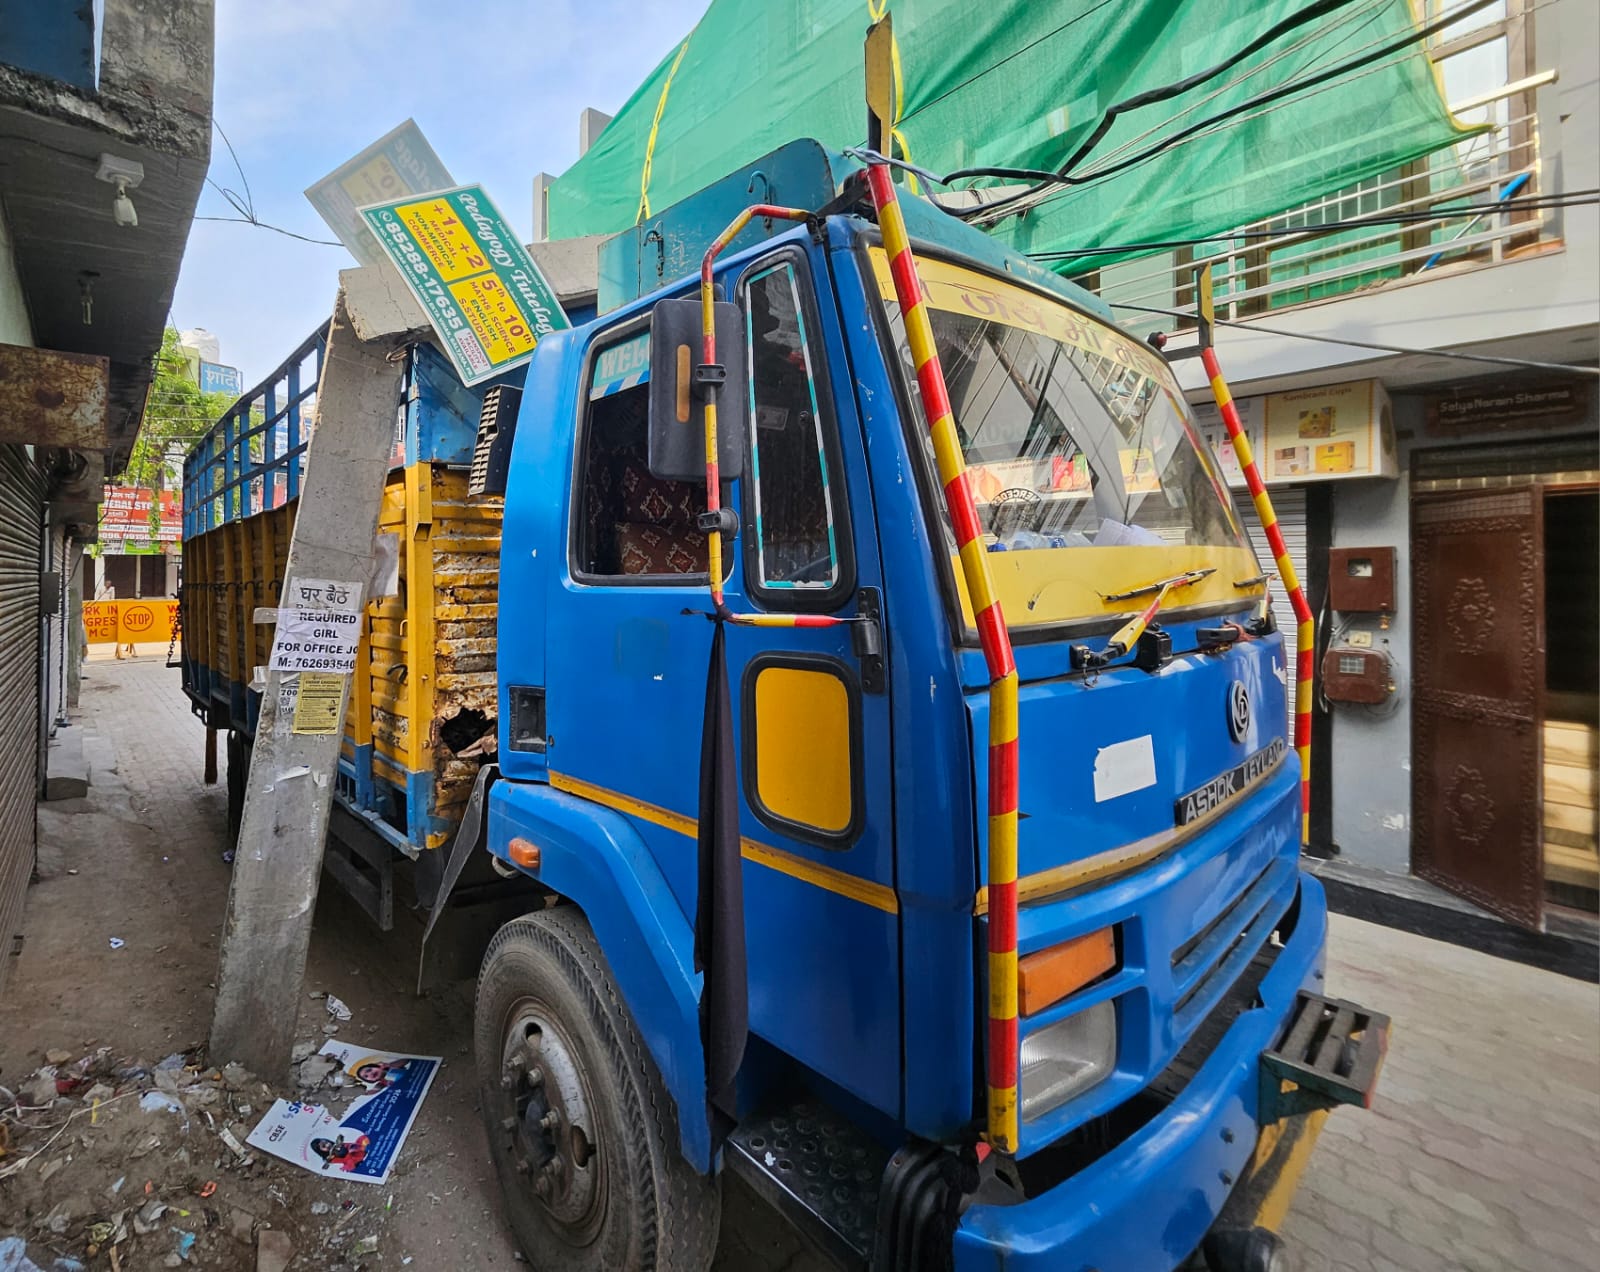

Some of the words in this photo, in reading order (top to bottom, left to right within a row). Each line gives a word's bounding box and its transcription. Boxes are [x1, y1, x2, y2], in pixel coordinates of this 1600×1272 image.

[408, 219, 445, 268] COMMERCE
[413, 211, 456, 271] NON-MEDICAL
[429, 220, 458, 258] MEDICAL
[459, 193, 514, 267] Pedagogy
[385, 221, 464, 329] 85288-17635
[470, 281, 492, 310] MATHS
[491, 317, 516, 353] SCIENCE
[470, 299, 499, 341] ENGLISH
[496, 302, 506, 313] to
[459, 298, 492, 349] S.STUDIES
[300, 587, 321, 601] घर
[108, 605, 118, 614] IN
[127, 614, 150, 625] STOP
[300, 612, 357, 624] REQUIRED
[313, 629, 338, 638] GIRL
[277, 642, 300, 652] FOR
[304, 643, 342, 654] OFFICE
[278, 656, 292, 667] M:
[1186, 771, 1236, 823] ASHOK
[269, 1124, 285, 1142] CBSE
